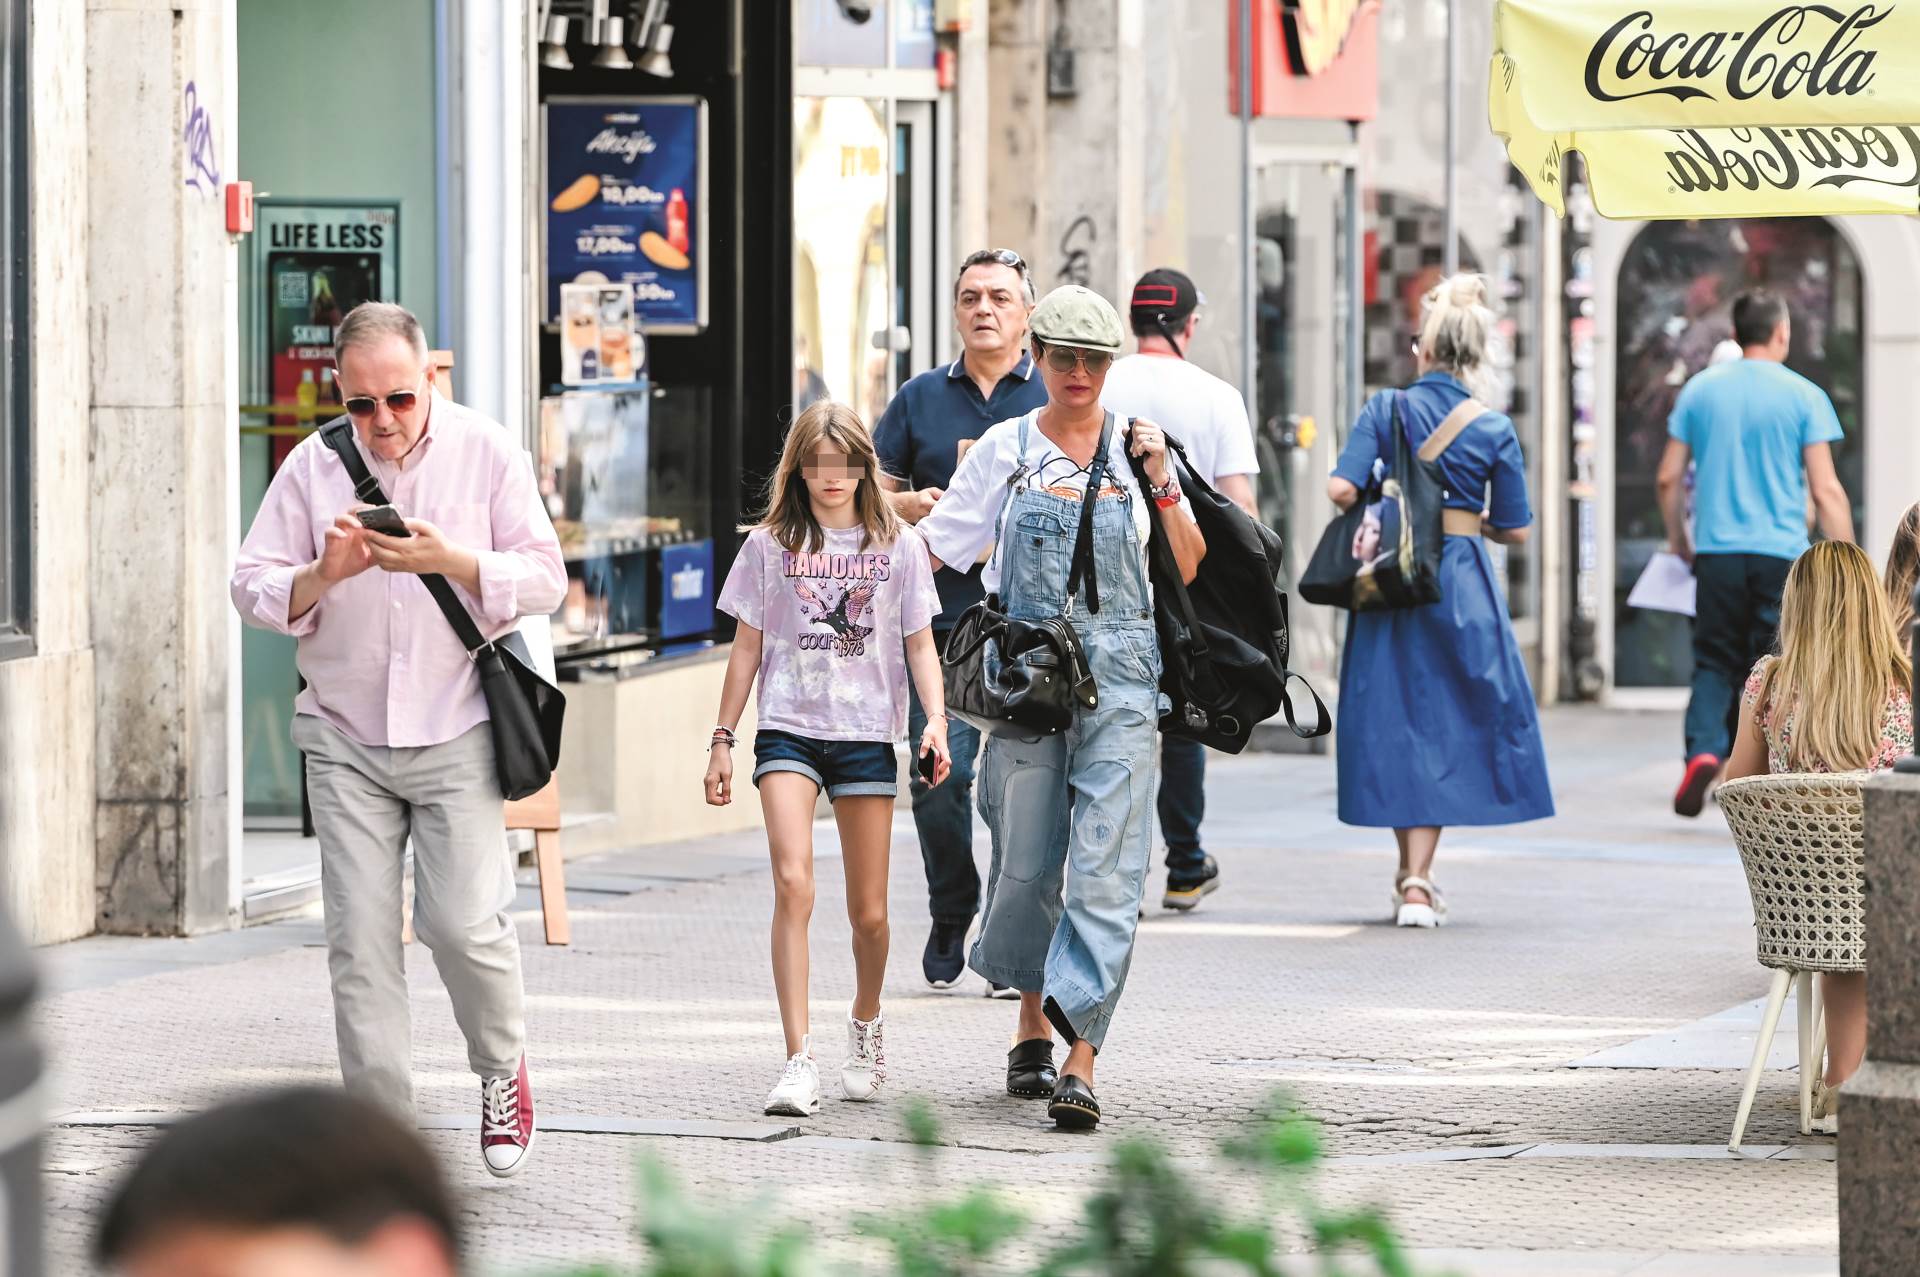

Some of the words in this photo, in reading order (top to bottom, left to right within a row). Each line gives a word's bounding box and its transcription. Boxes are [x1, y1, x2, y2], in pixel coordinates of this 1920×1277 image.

[1584, 4, 1896, 103] Coca-Cola
[271, 223, 318, 248] LIFE
[326, 223, 383, 248] LESS
[782, 551, 891, 581] RAMONES
[837, 640, 865, 657] 1978
